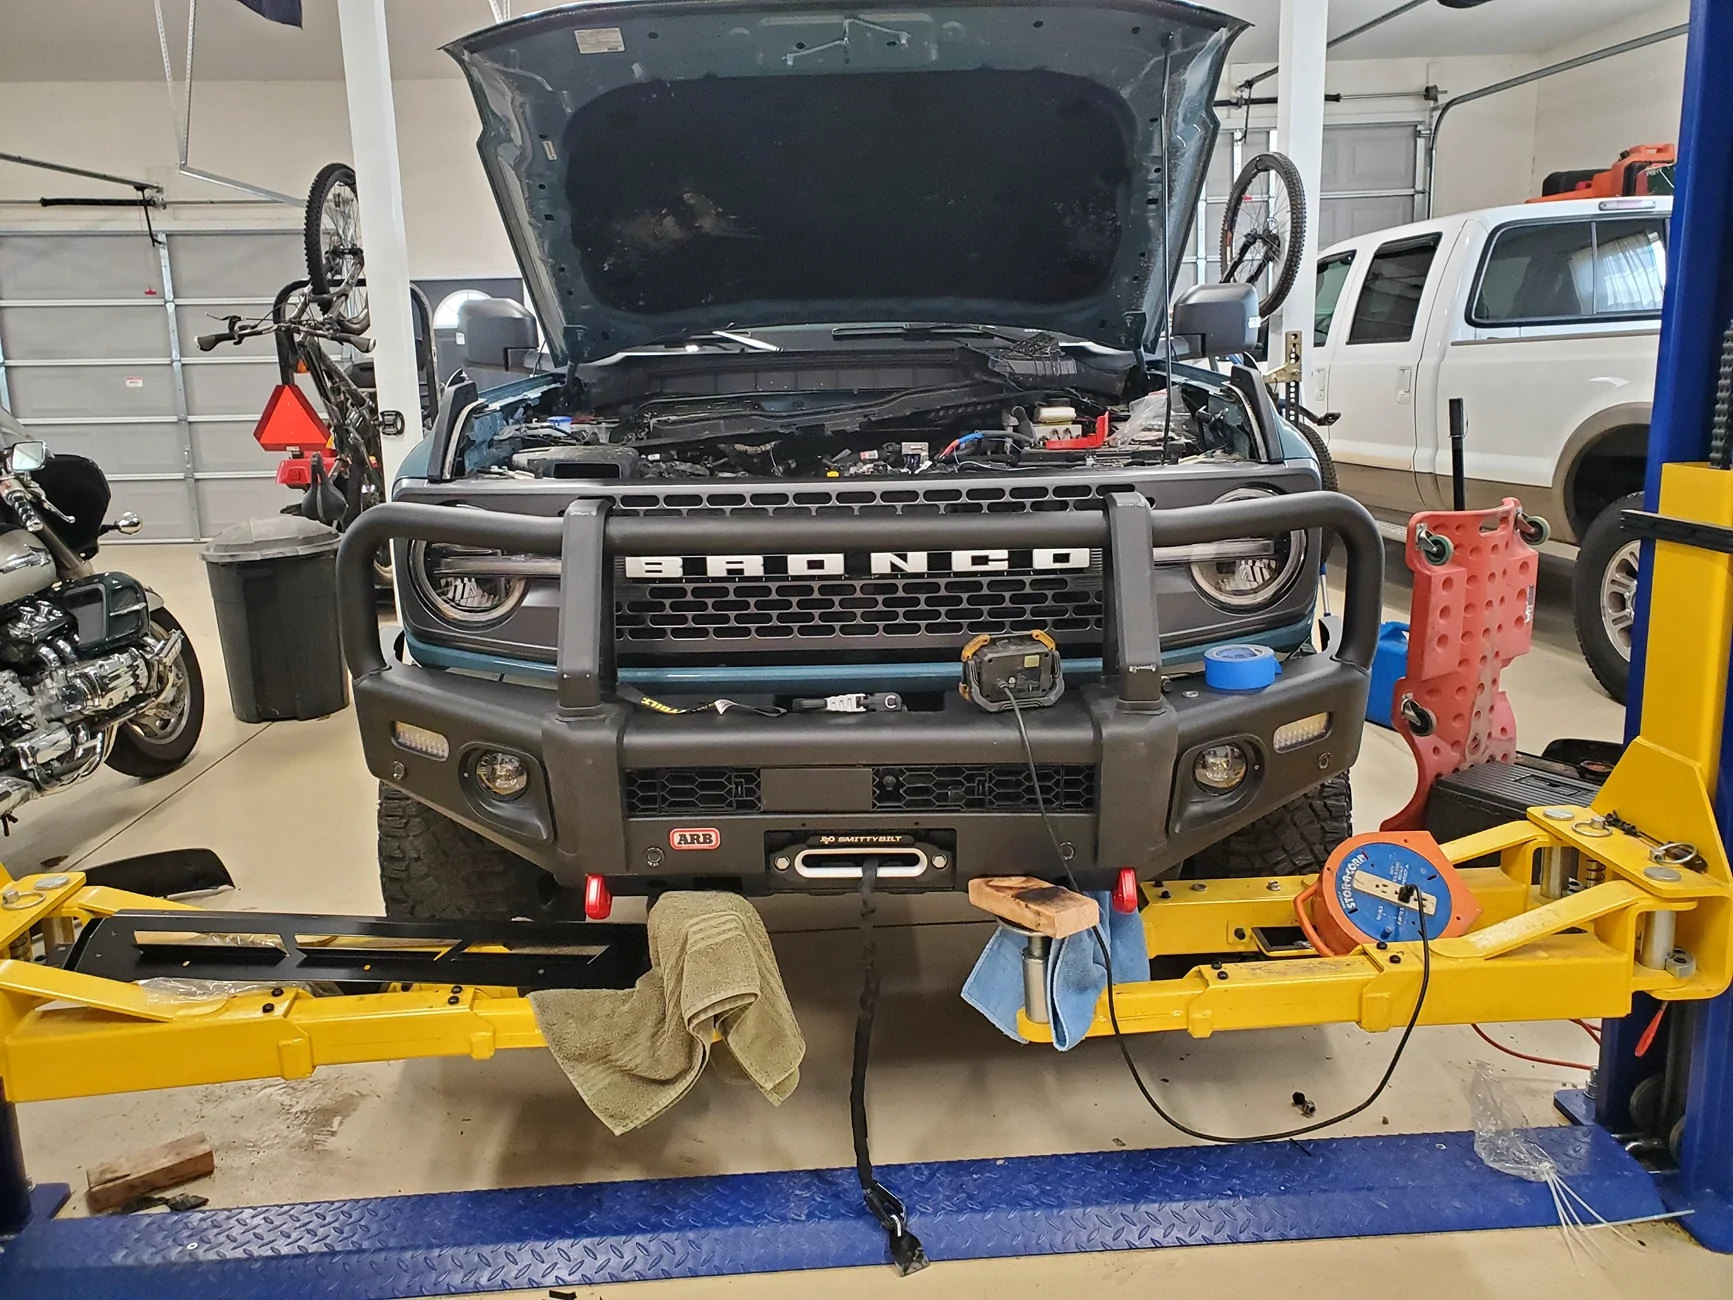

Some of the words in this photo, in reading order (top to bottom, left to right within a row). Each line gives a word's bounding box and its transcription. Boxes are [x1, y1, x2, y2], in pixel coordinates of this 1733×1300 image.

[625, 548, 1091, 578] BRONCO
[677, 833, 714, 845] ARB
[838, 835, 902, 843] SMITTYBILT
